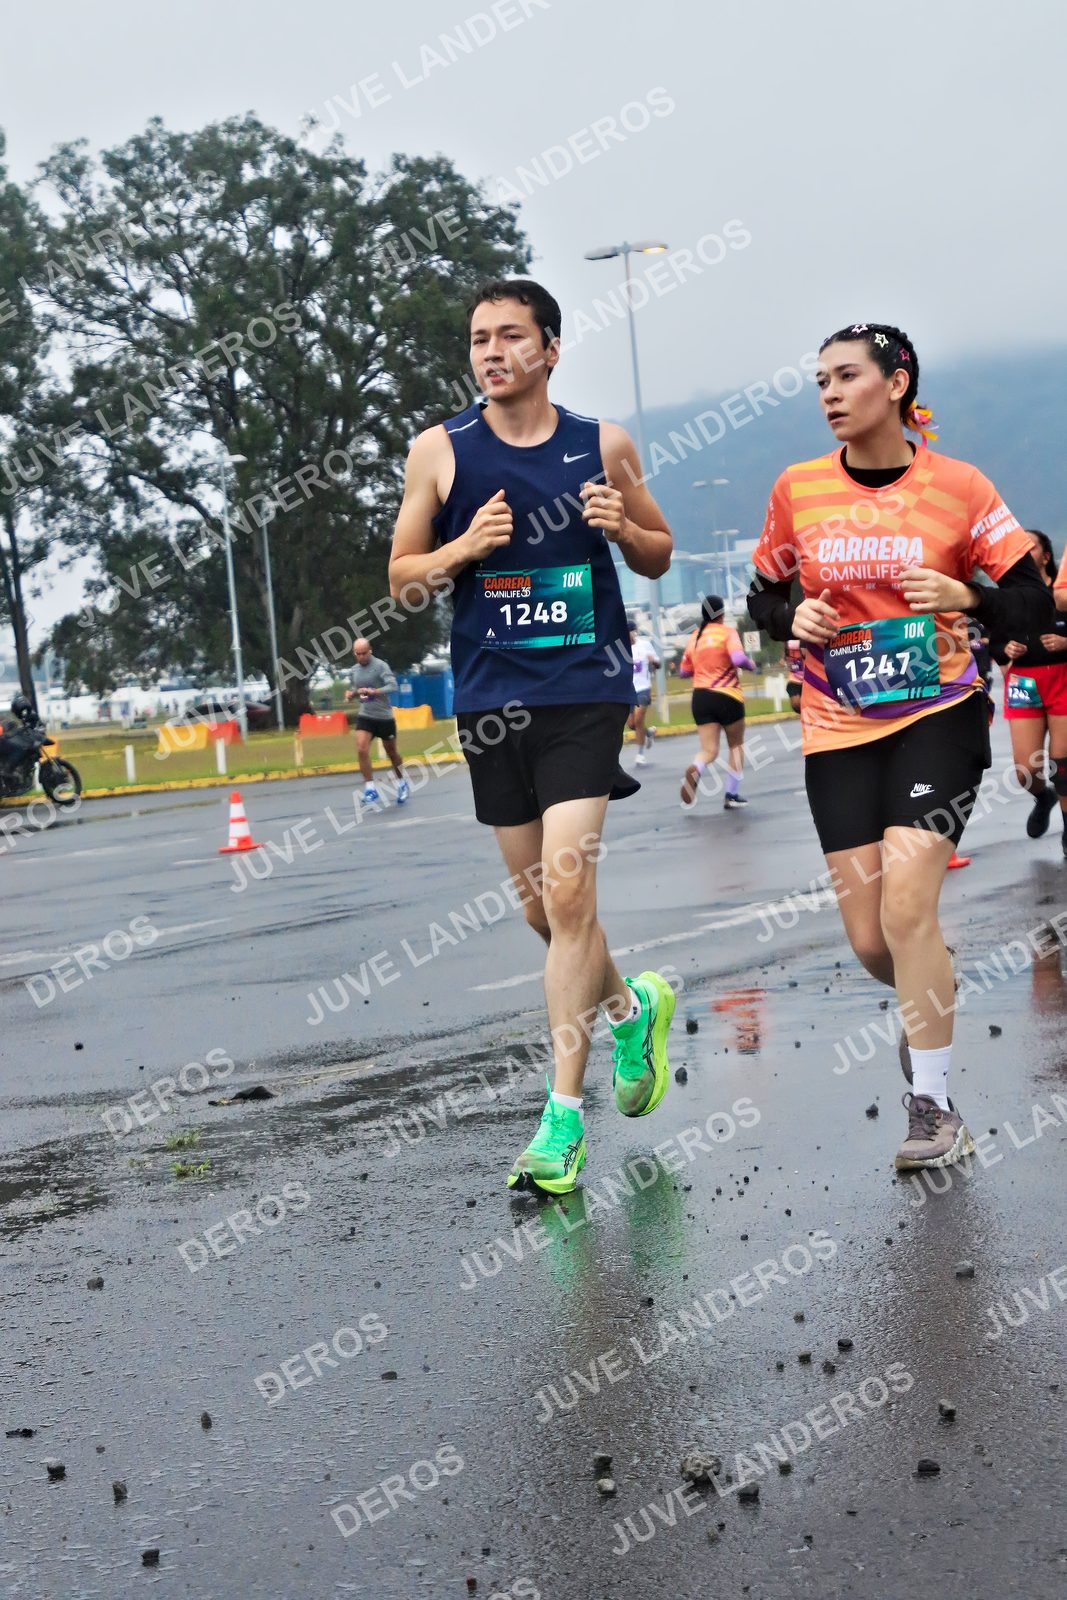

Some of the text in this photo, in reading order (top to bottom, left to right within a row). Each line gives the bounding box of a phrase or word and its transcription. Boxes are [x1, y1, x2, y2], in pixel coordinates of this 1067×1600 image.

[817, 536, 924, 563] CARRERA
[484, 575, 531, 589] CARRERA
[562, 571, 583, 588] 10K
[819, 563, 900, 582] OMNILIFE
[500, 600, 568, 626] 1248
[903, 621, 925, 640] 10K
[845, 651, 911, 681] 1247
[913, 782, 933, 792] NIKE
